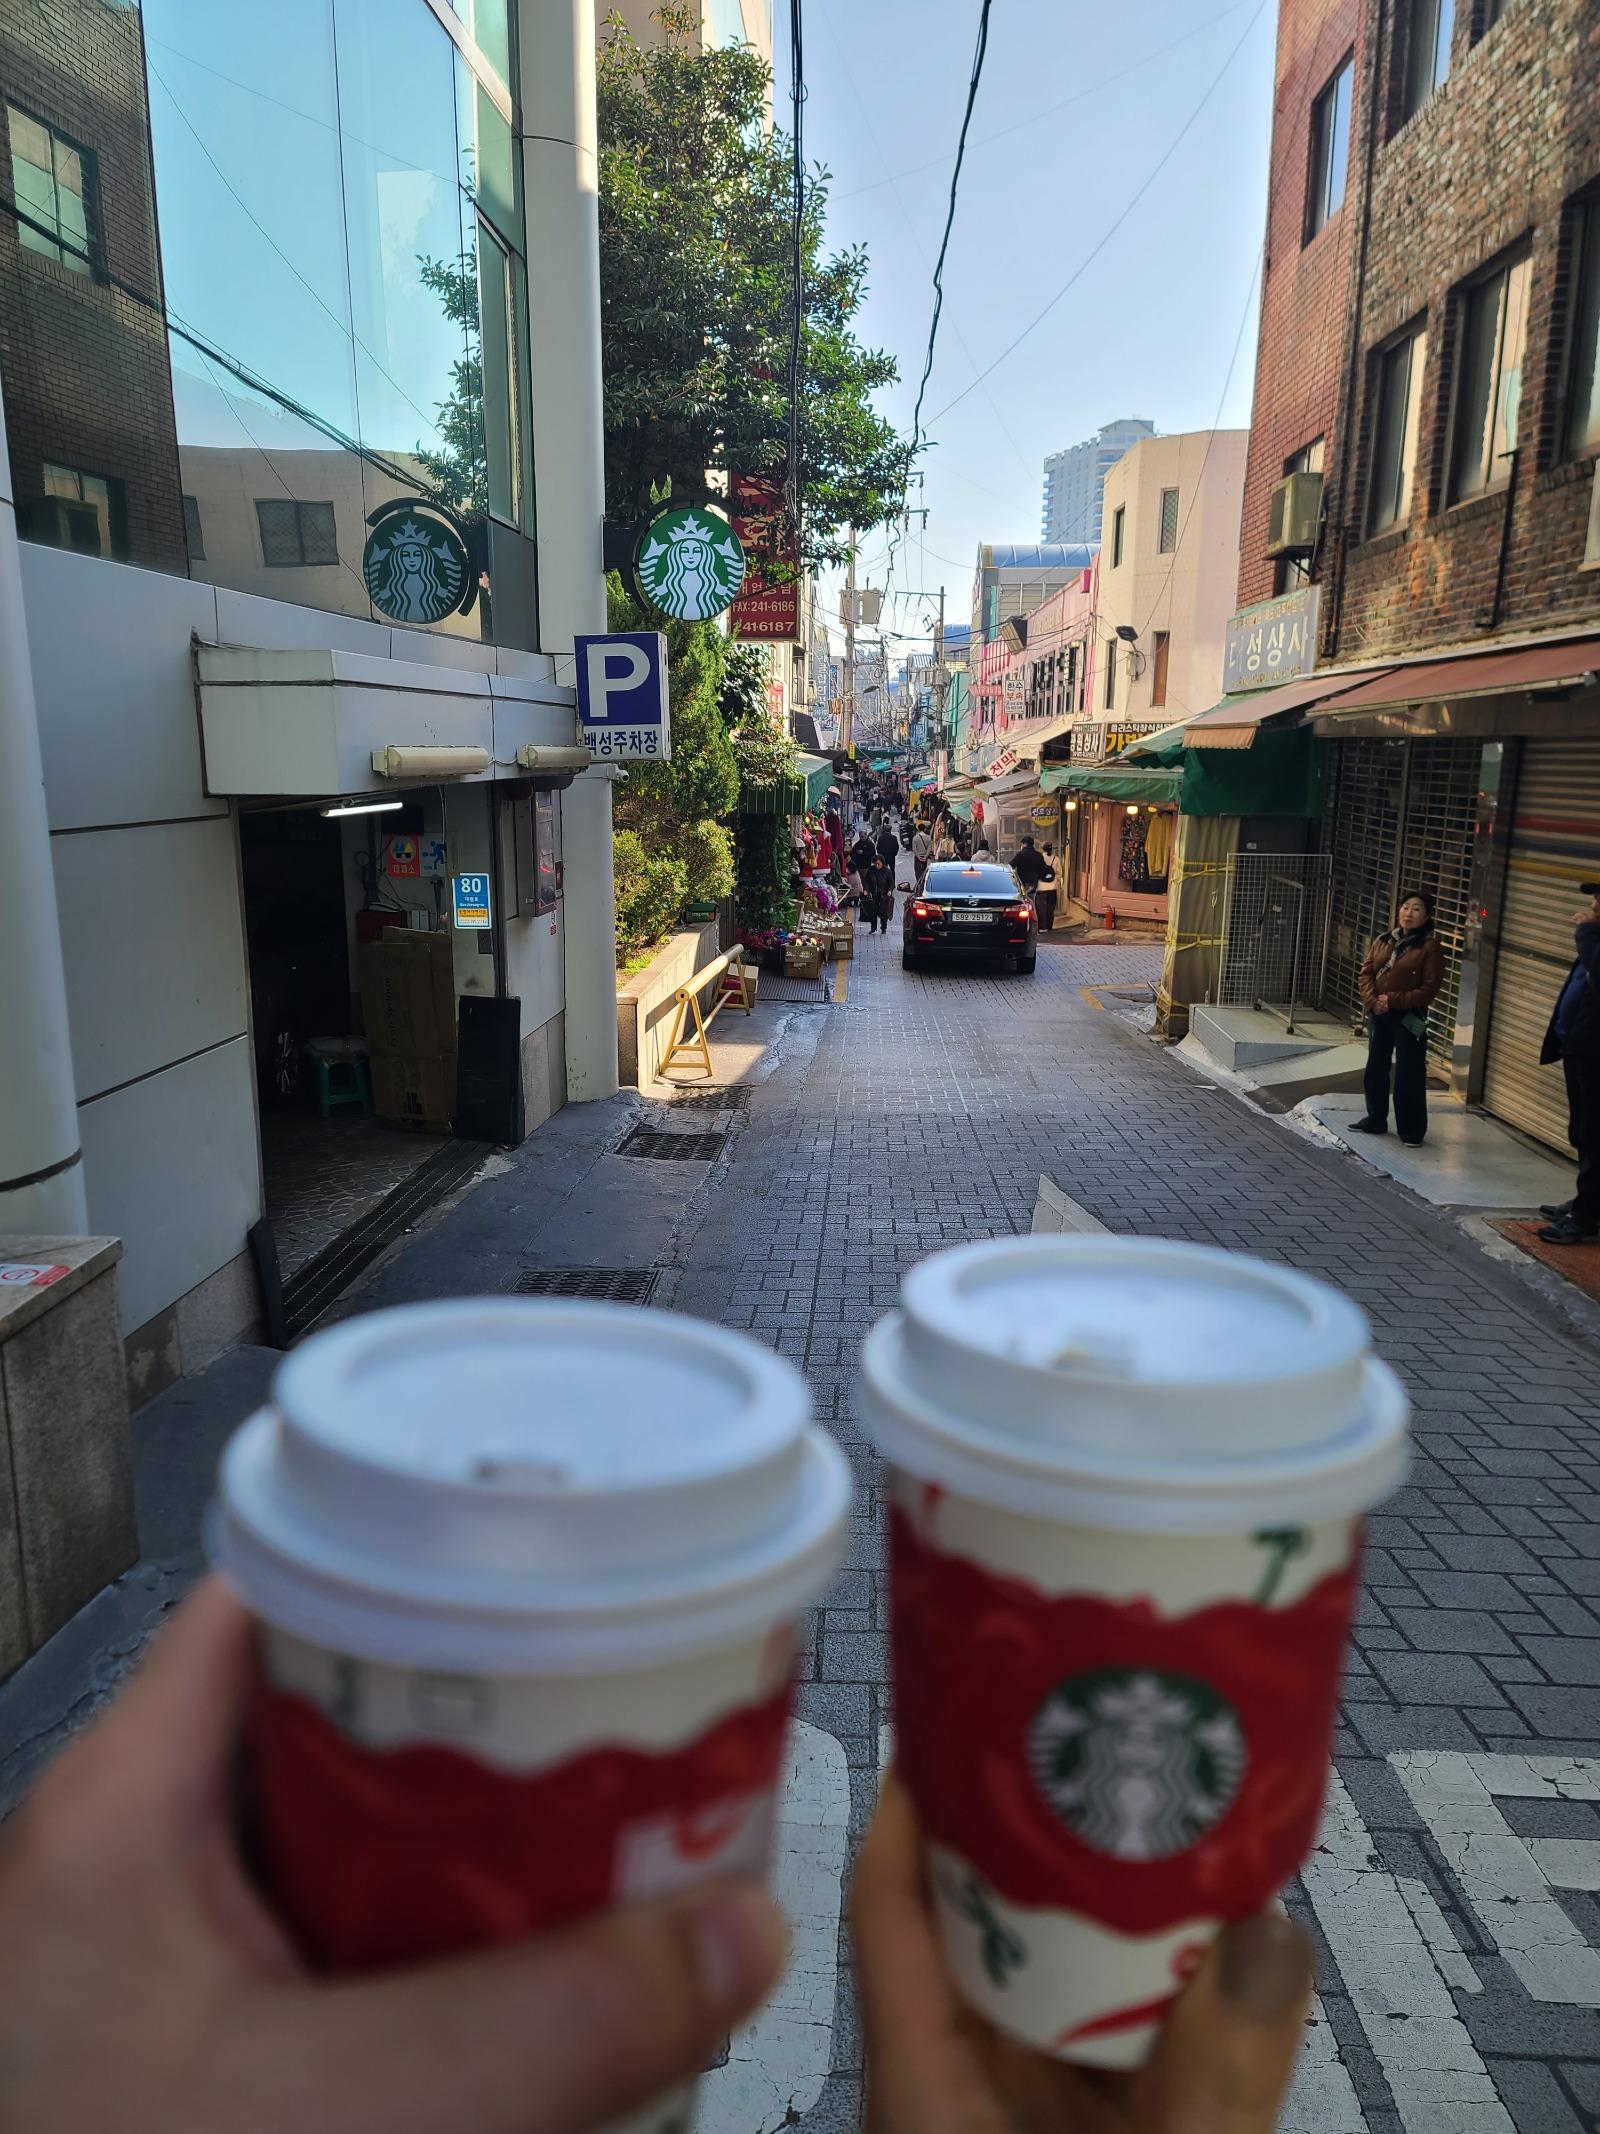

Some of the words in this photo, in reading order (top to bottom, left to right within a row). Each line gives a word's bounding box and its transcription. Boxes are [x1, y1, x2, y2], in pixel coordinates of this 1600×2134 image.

[586, 642, 651, 718] P
[584, 730, 658, 756] 백성주차장
[990, 752, 1017, 777] 천막
[461, 878, 481, 893] 80
